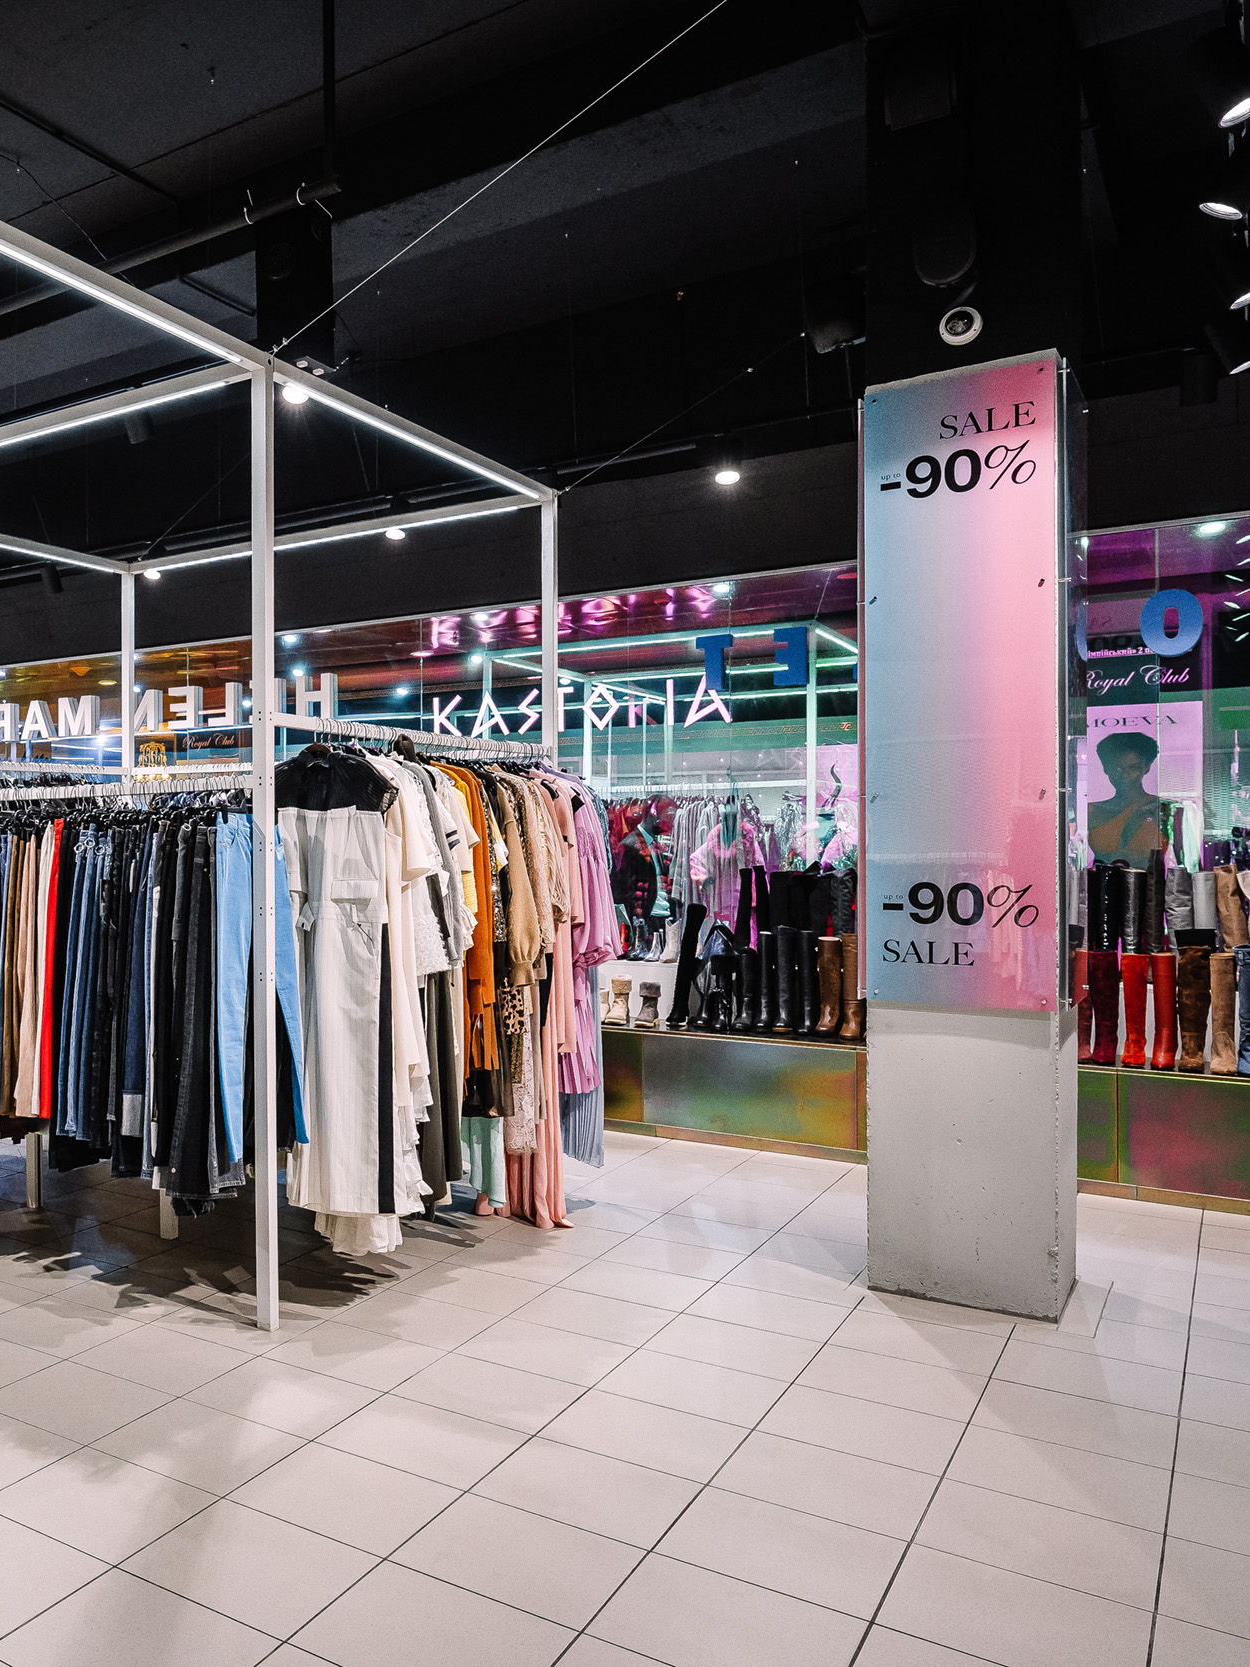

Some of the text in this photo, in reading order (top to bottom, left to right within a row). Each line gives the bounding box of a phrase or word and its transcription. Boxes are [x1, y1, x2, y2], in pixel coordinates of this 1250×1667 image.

[939, 401, 1037, 440] SALE
[880, 439, 1037, 499] -90%
[1086, 664, 1191, 697] Royal Club
[182, 732, 235, 752] Royal Club
[882, 881, 1039, 928] -90%
[882, 938, 975, 966] SALE
